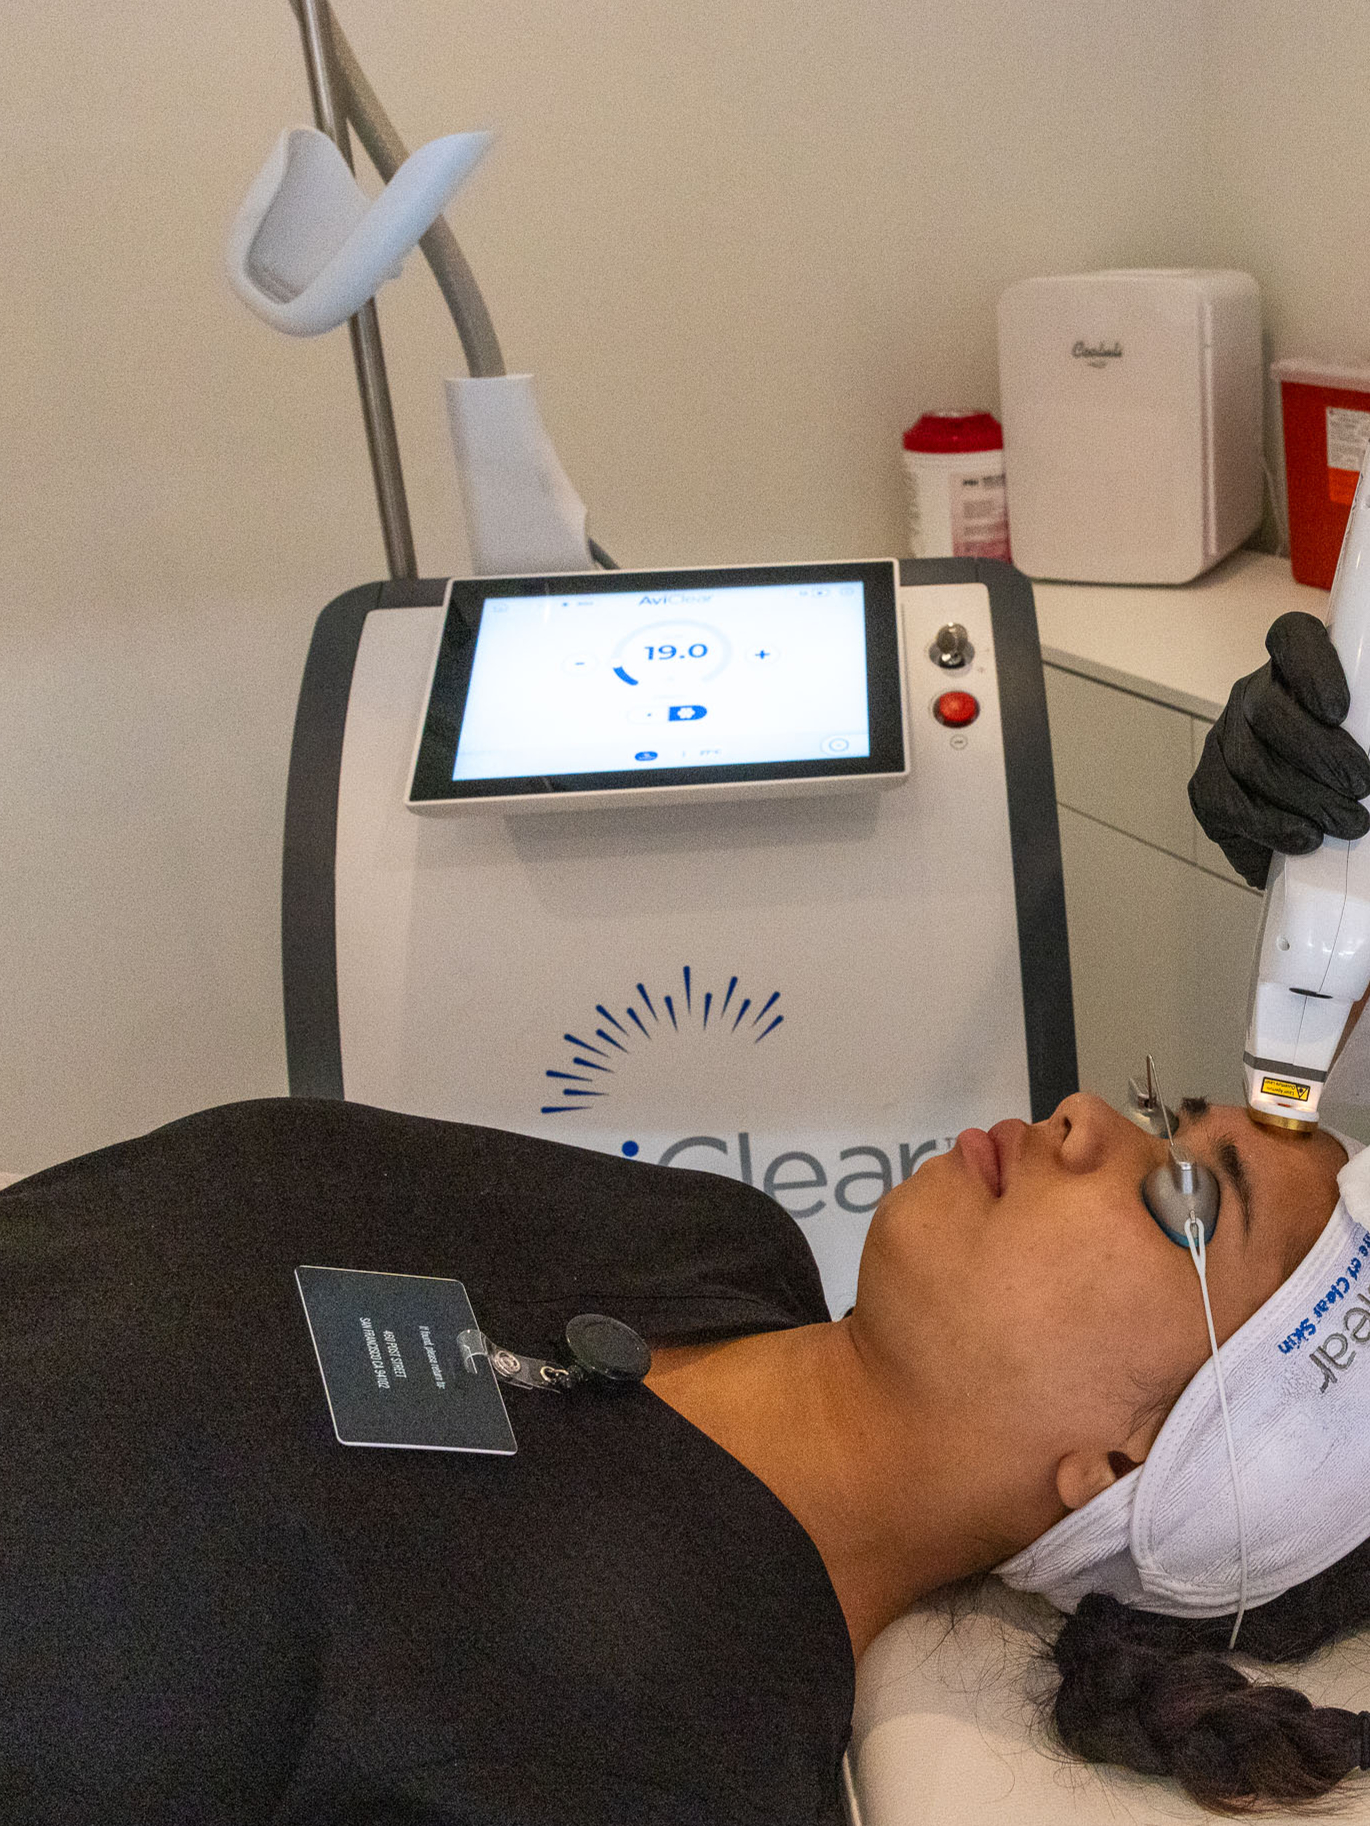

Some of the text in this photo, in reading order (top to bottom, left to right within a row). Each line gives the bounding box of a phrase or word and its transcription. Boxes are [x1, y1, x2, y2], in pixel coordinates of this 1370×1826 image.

[638, 594, 713, 606] AviClear
[644, 643, 708, 661] 19.0
[1312, 1276, 1351, 1318] Clear
[360, 1317, 372, 1329] SAN
[363, 1329, 382, 1361] FRANCISCO
[1277, 1317, 1317, 1355] Skin
[386, 1342, 401, 1357] POST
[372, 1360, 385, 1369] CA
[391, 1358, 407, 1379] STREET
